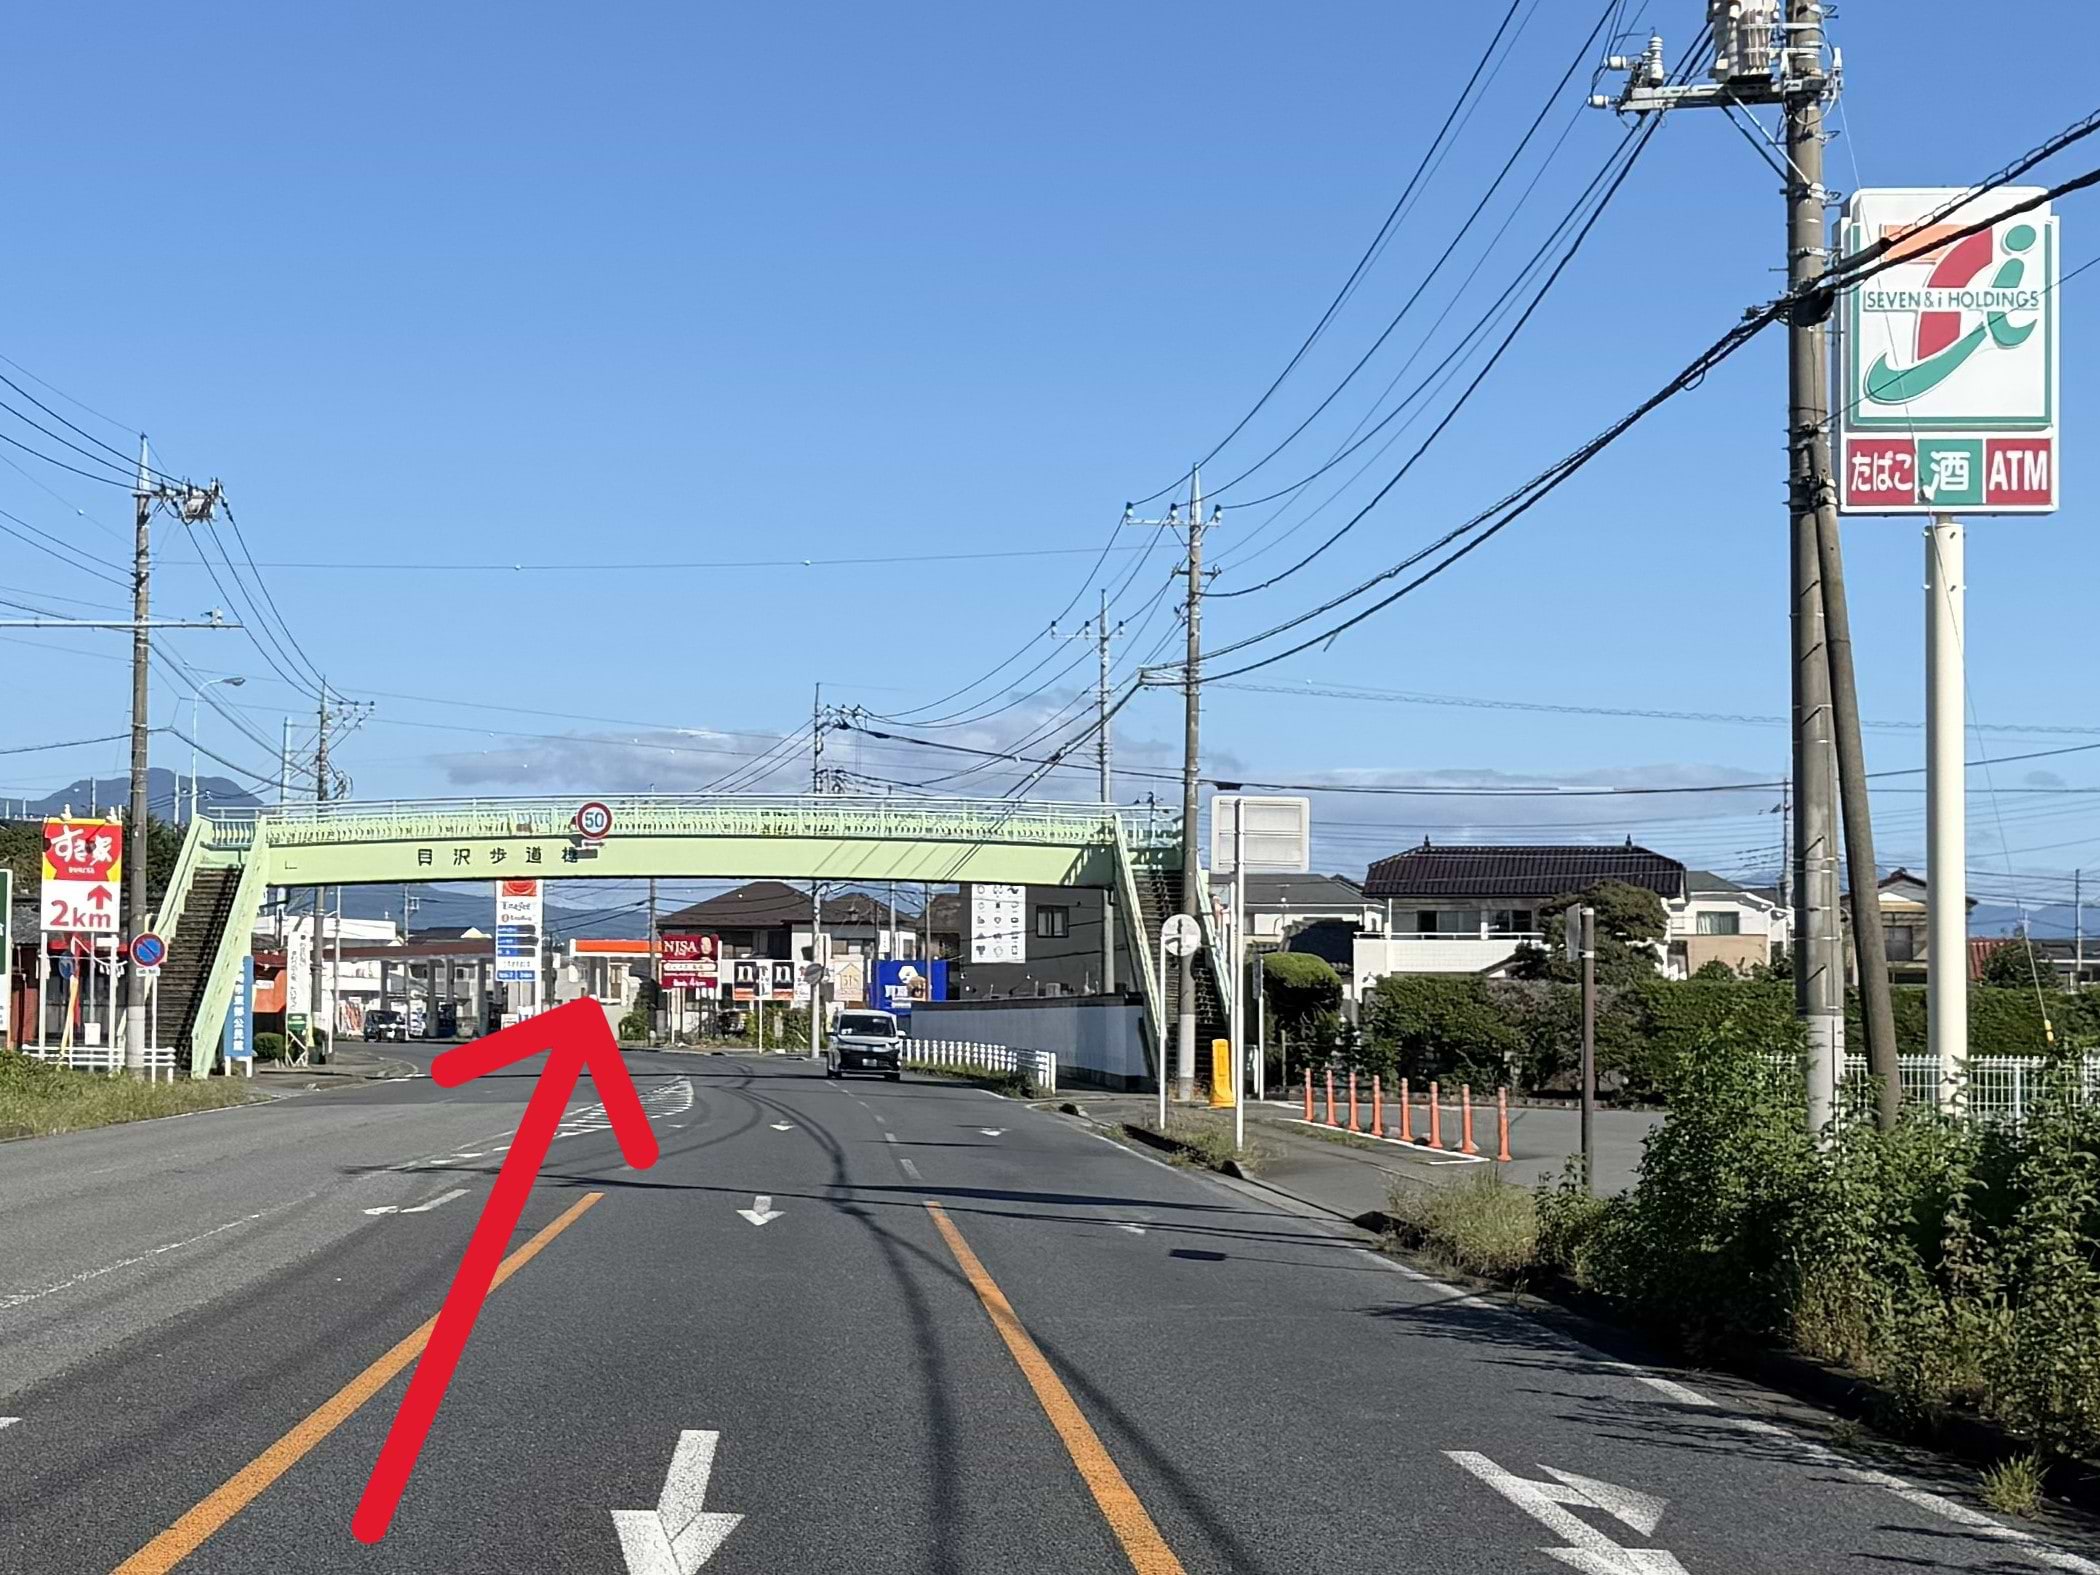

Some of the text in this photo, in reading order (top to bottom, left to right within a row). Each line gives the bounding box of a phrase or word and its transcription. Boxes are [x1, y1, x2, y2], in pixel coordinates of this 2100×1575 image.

[1948, 291, 2040, 308] HOLDINGS
[1851, 450, 1913, 492] たばこ
[1923, 451, 1972, 497] 酒
[1988, 449, 2048, 491] ATM
[584, 812, 605, 828] 50
[663, 940, 698, 956] NISA
